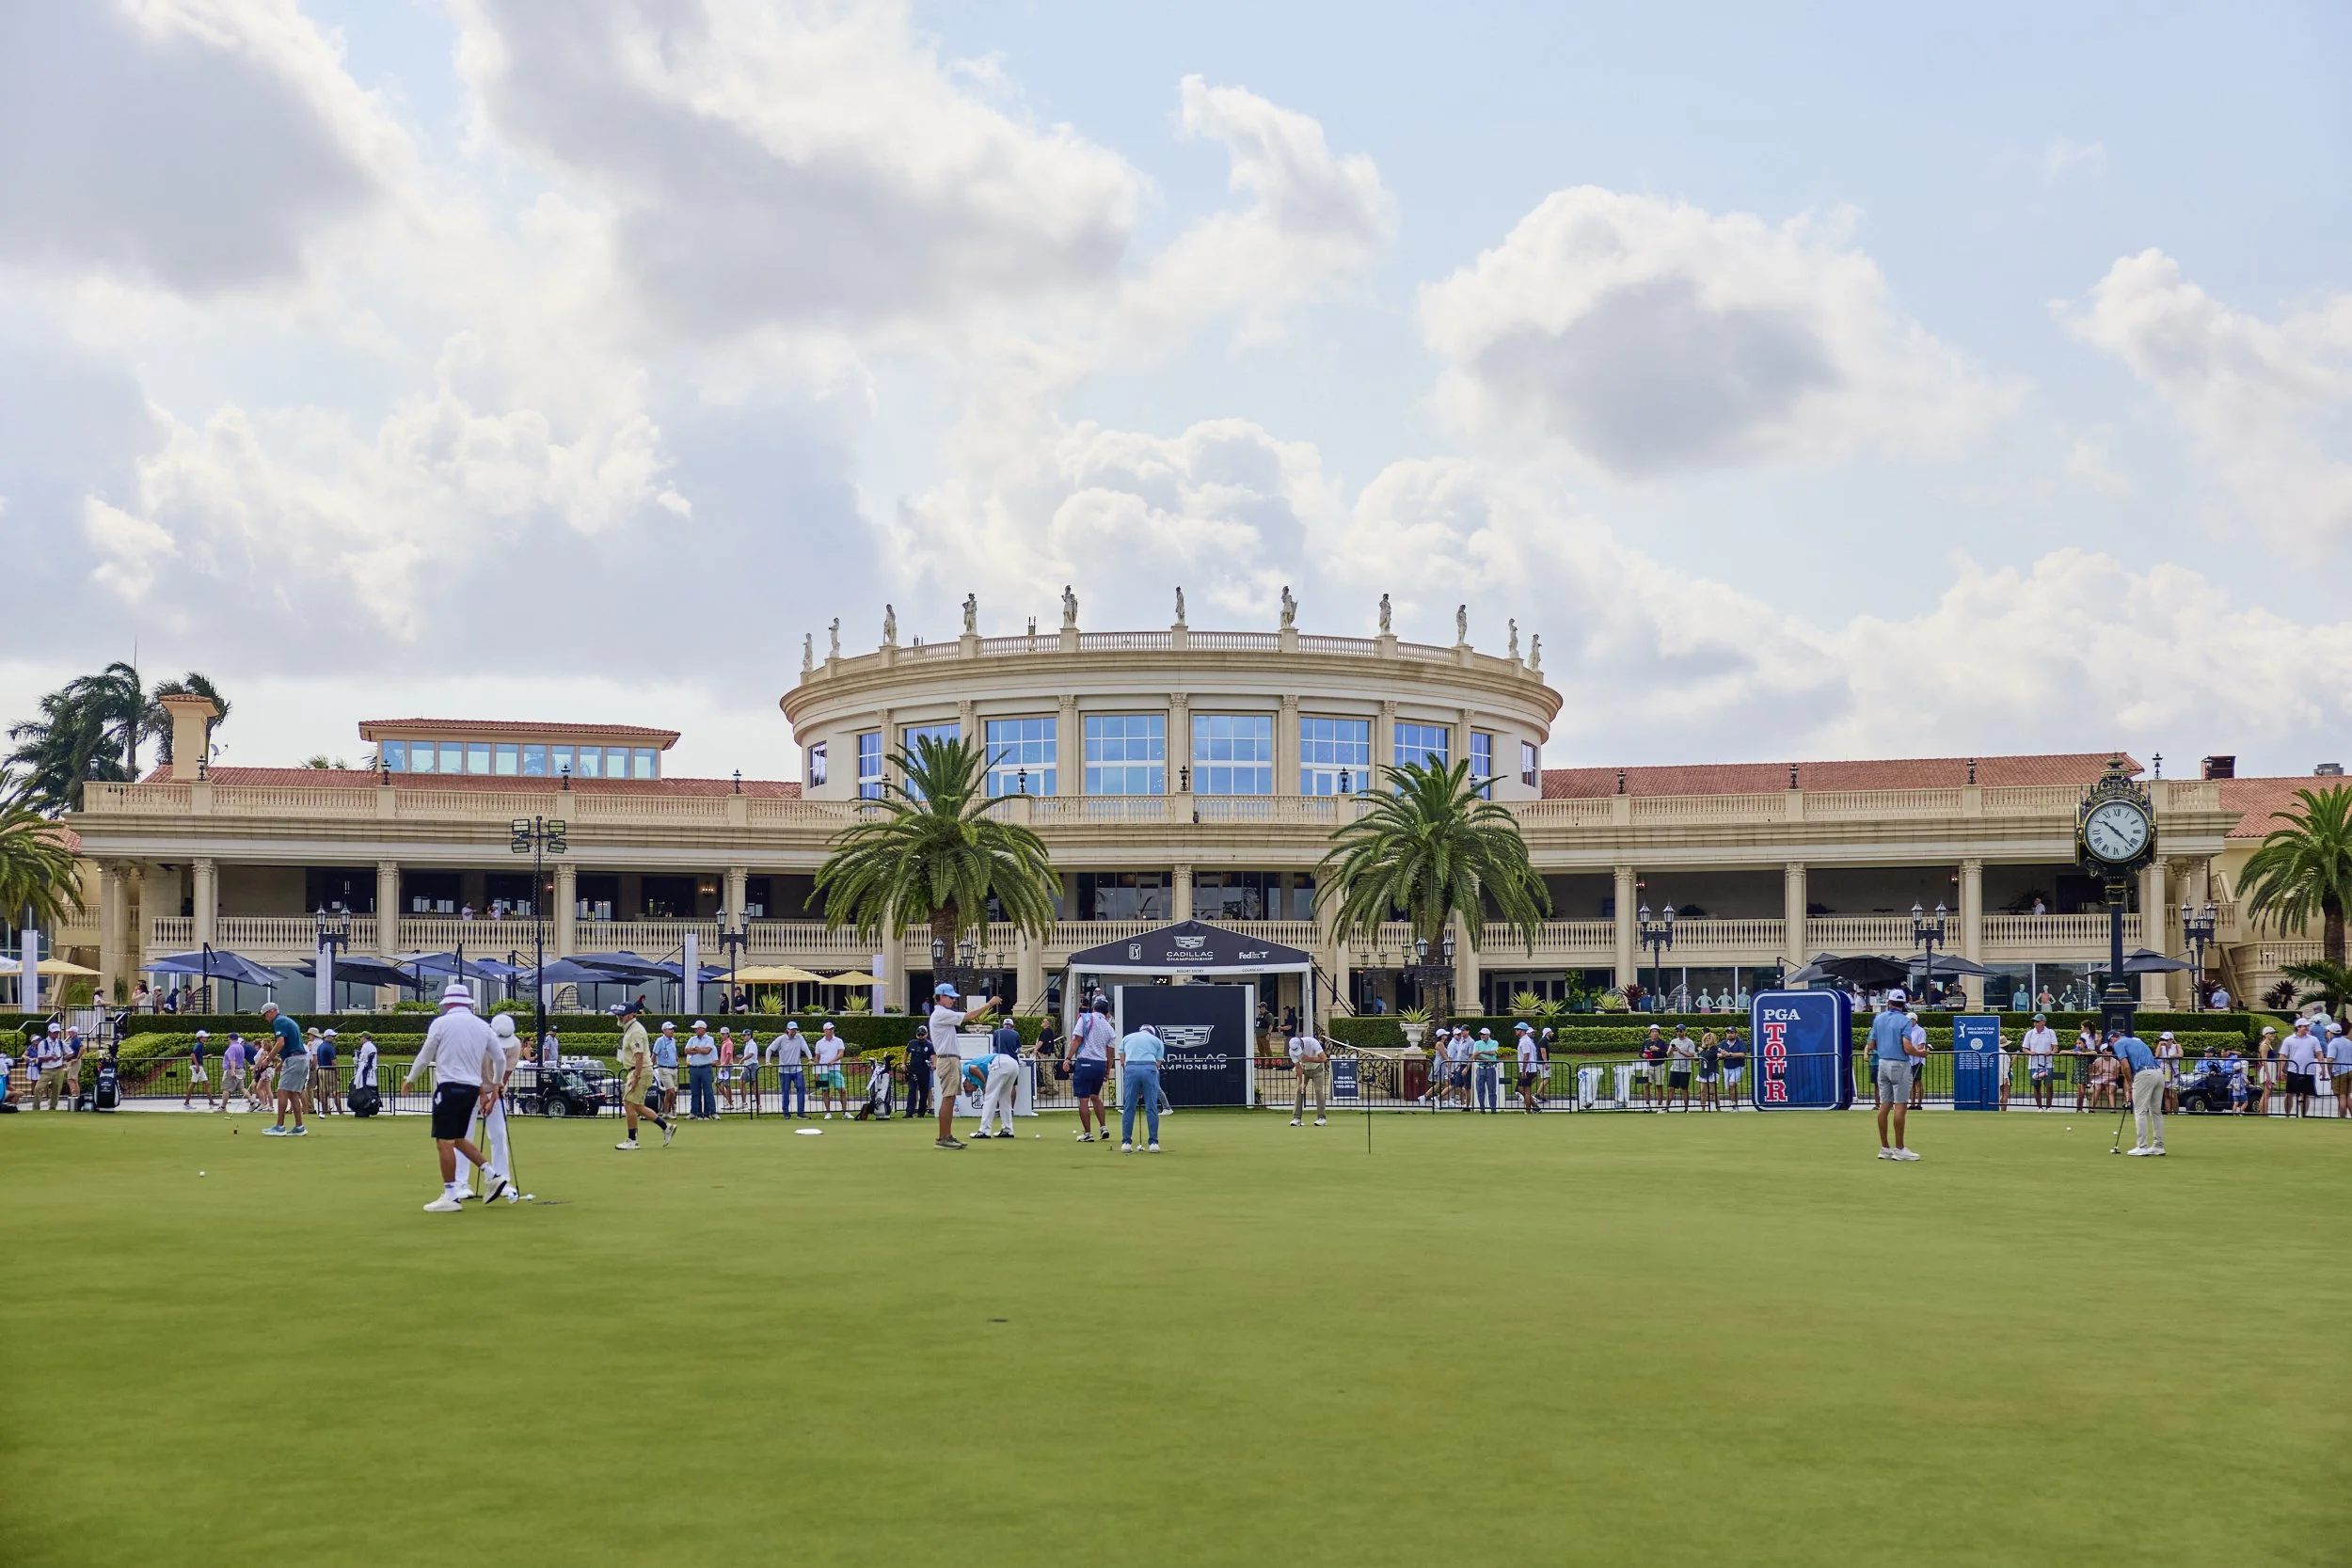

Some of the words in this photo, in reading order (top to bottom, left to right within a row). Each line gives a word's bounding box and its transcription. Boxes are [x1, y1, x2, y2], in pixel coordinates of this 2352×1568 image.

[1238, 951, 1261, 959] FedEx
[1763, 1008, 1801, 1021] PGA
[1763, 1022, 1788, 1101] TOUR
